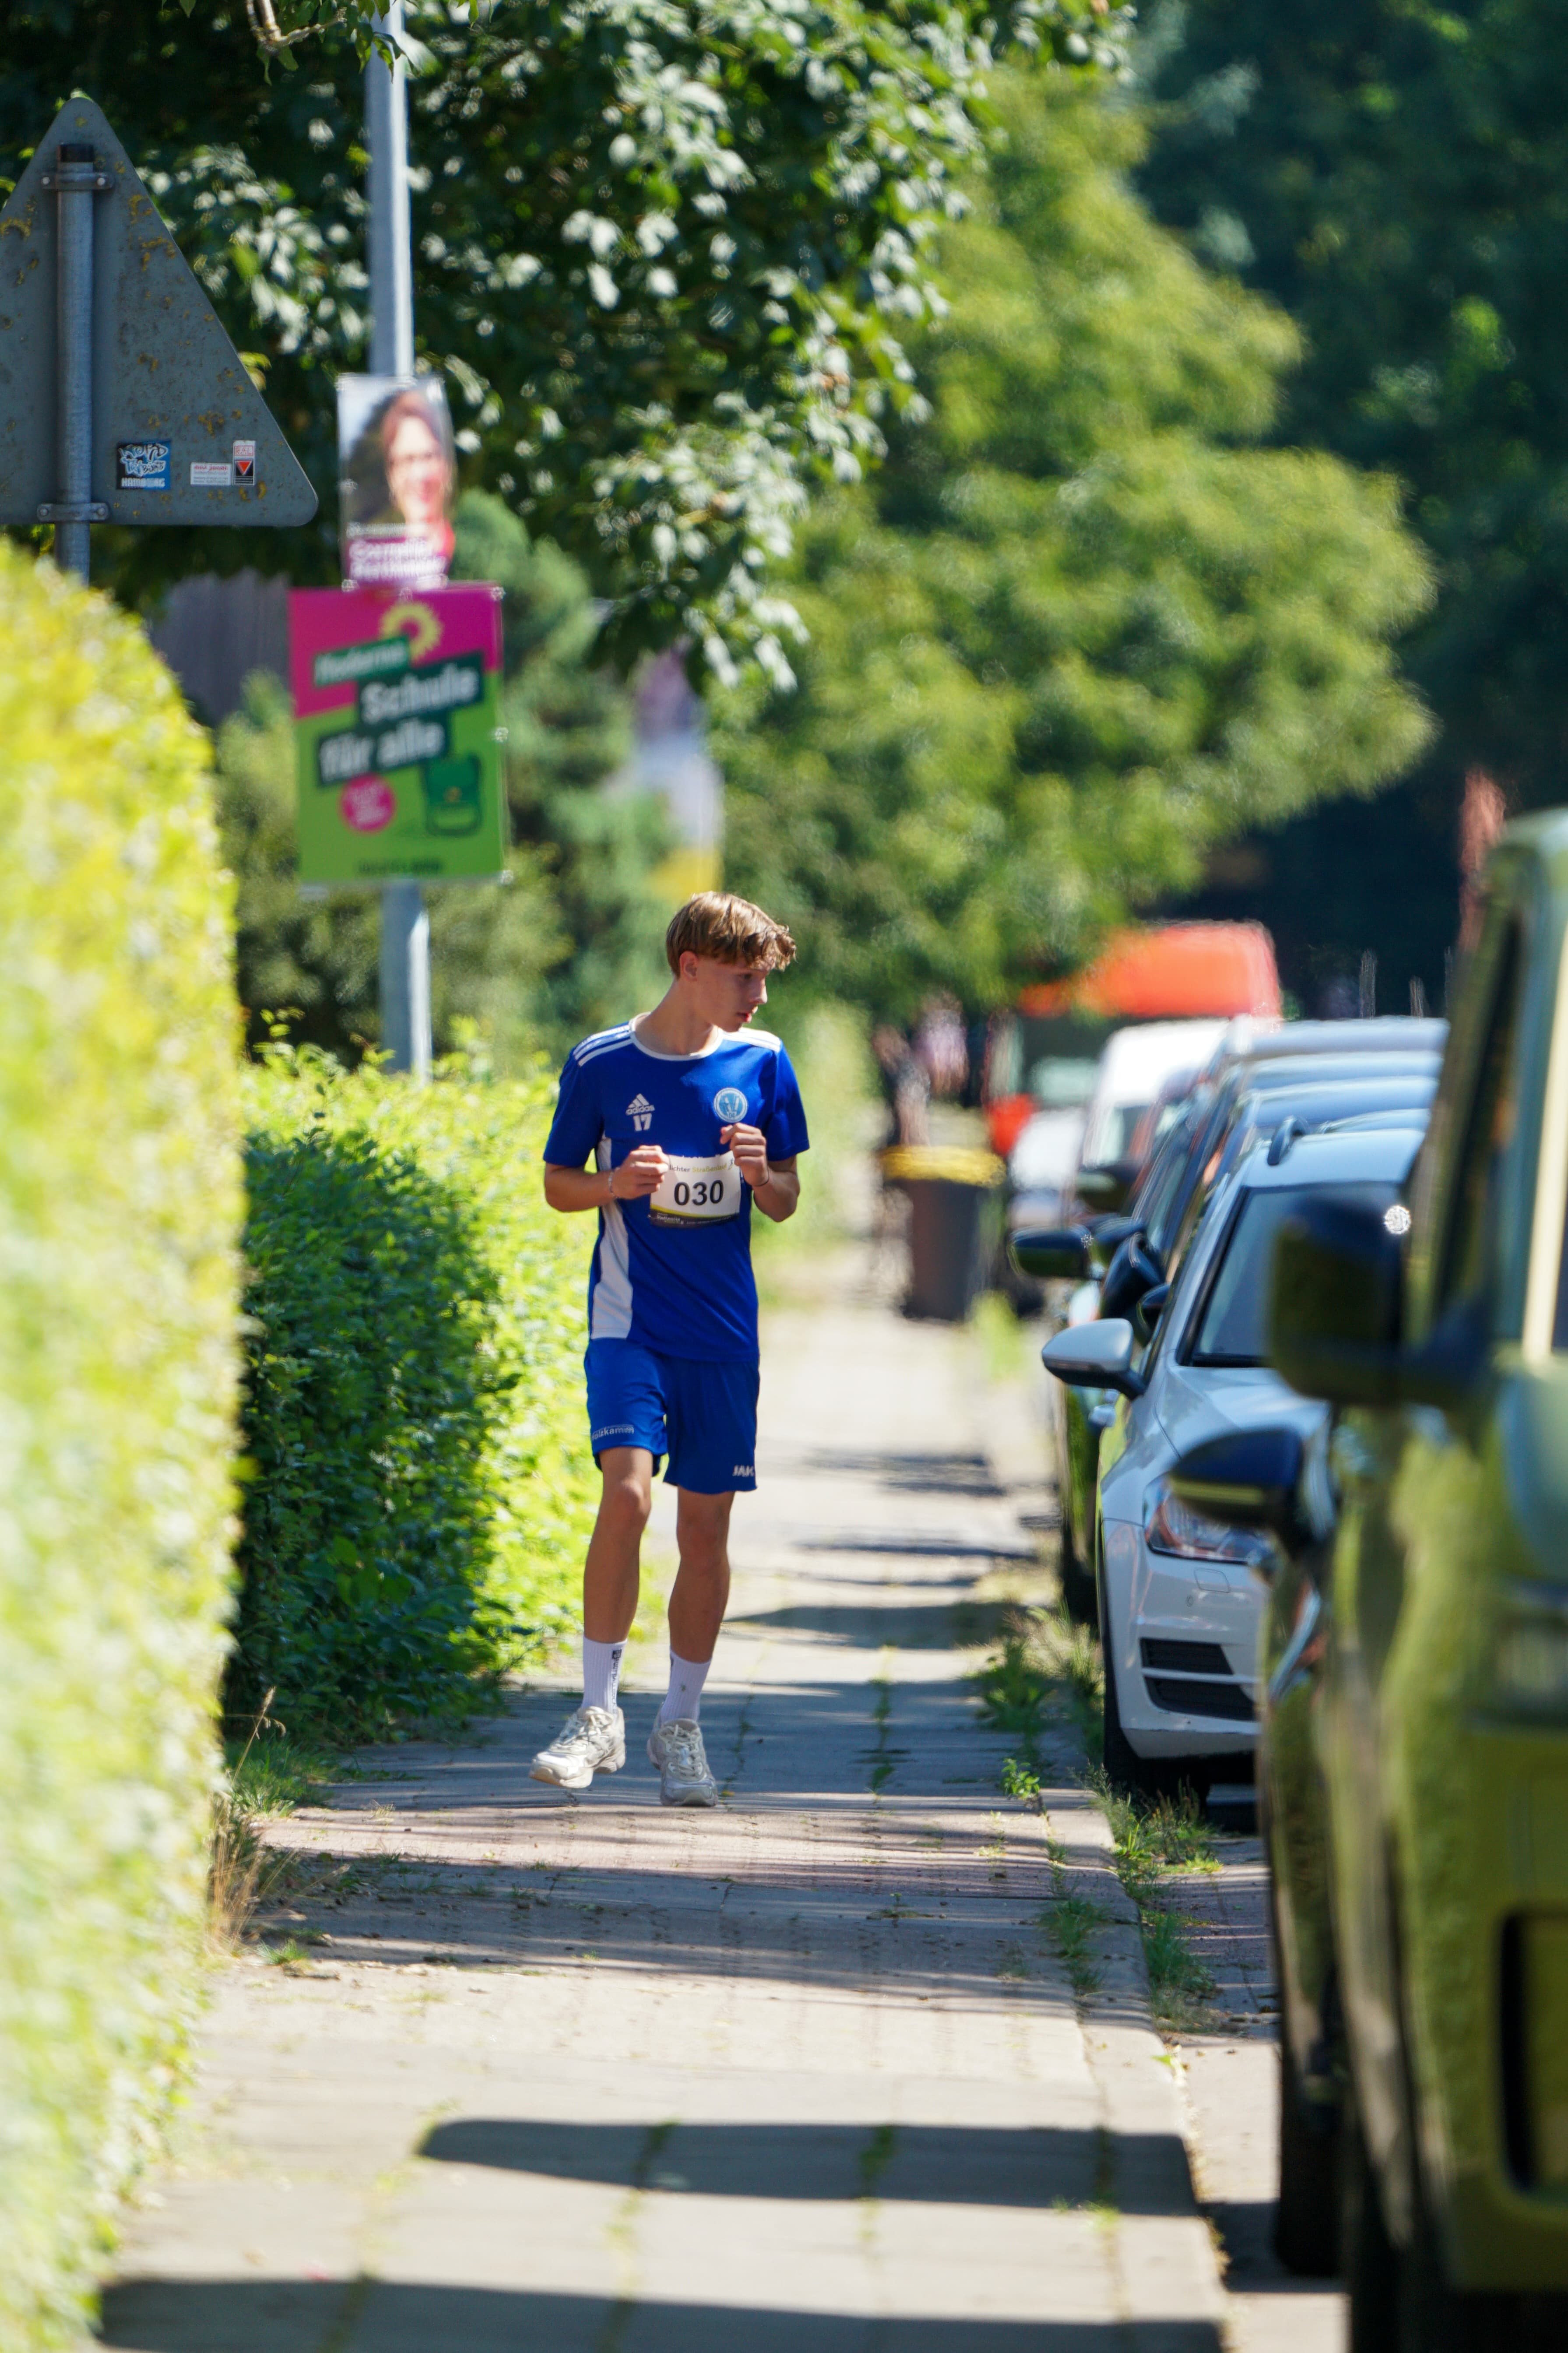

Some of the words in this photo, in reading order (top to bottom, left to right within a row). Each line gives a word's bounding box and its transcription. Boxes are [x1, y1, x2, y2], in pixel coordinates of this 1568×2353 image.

[361, 663, 479, 724] Schule
[377, 719, 444, 770] alle
[626, 1105, 655, 1116] adidas
[633, 1113, 652, 1131] 17
[674, 1180, 724, 1205] 030
